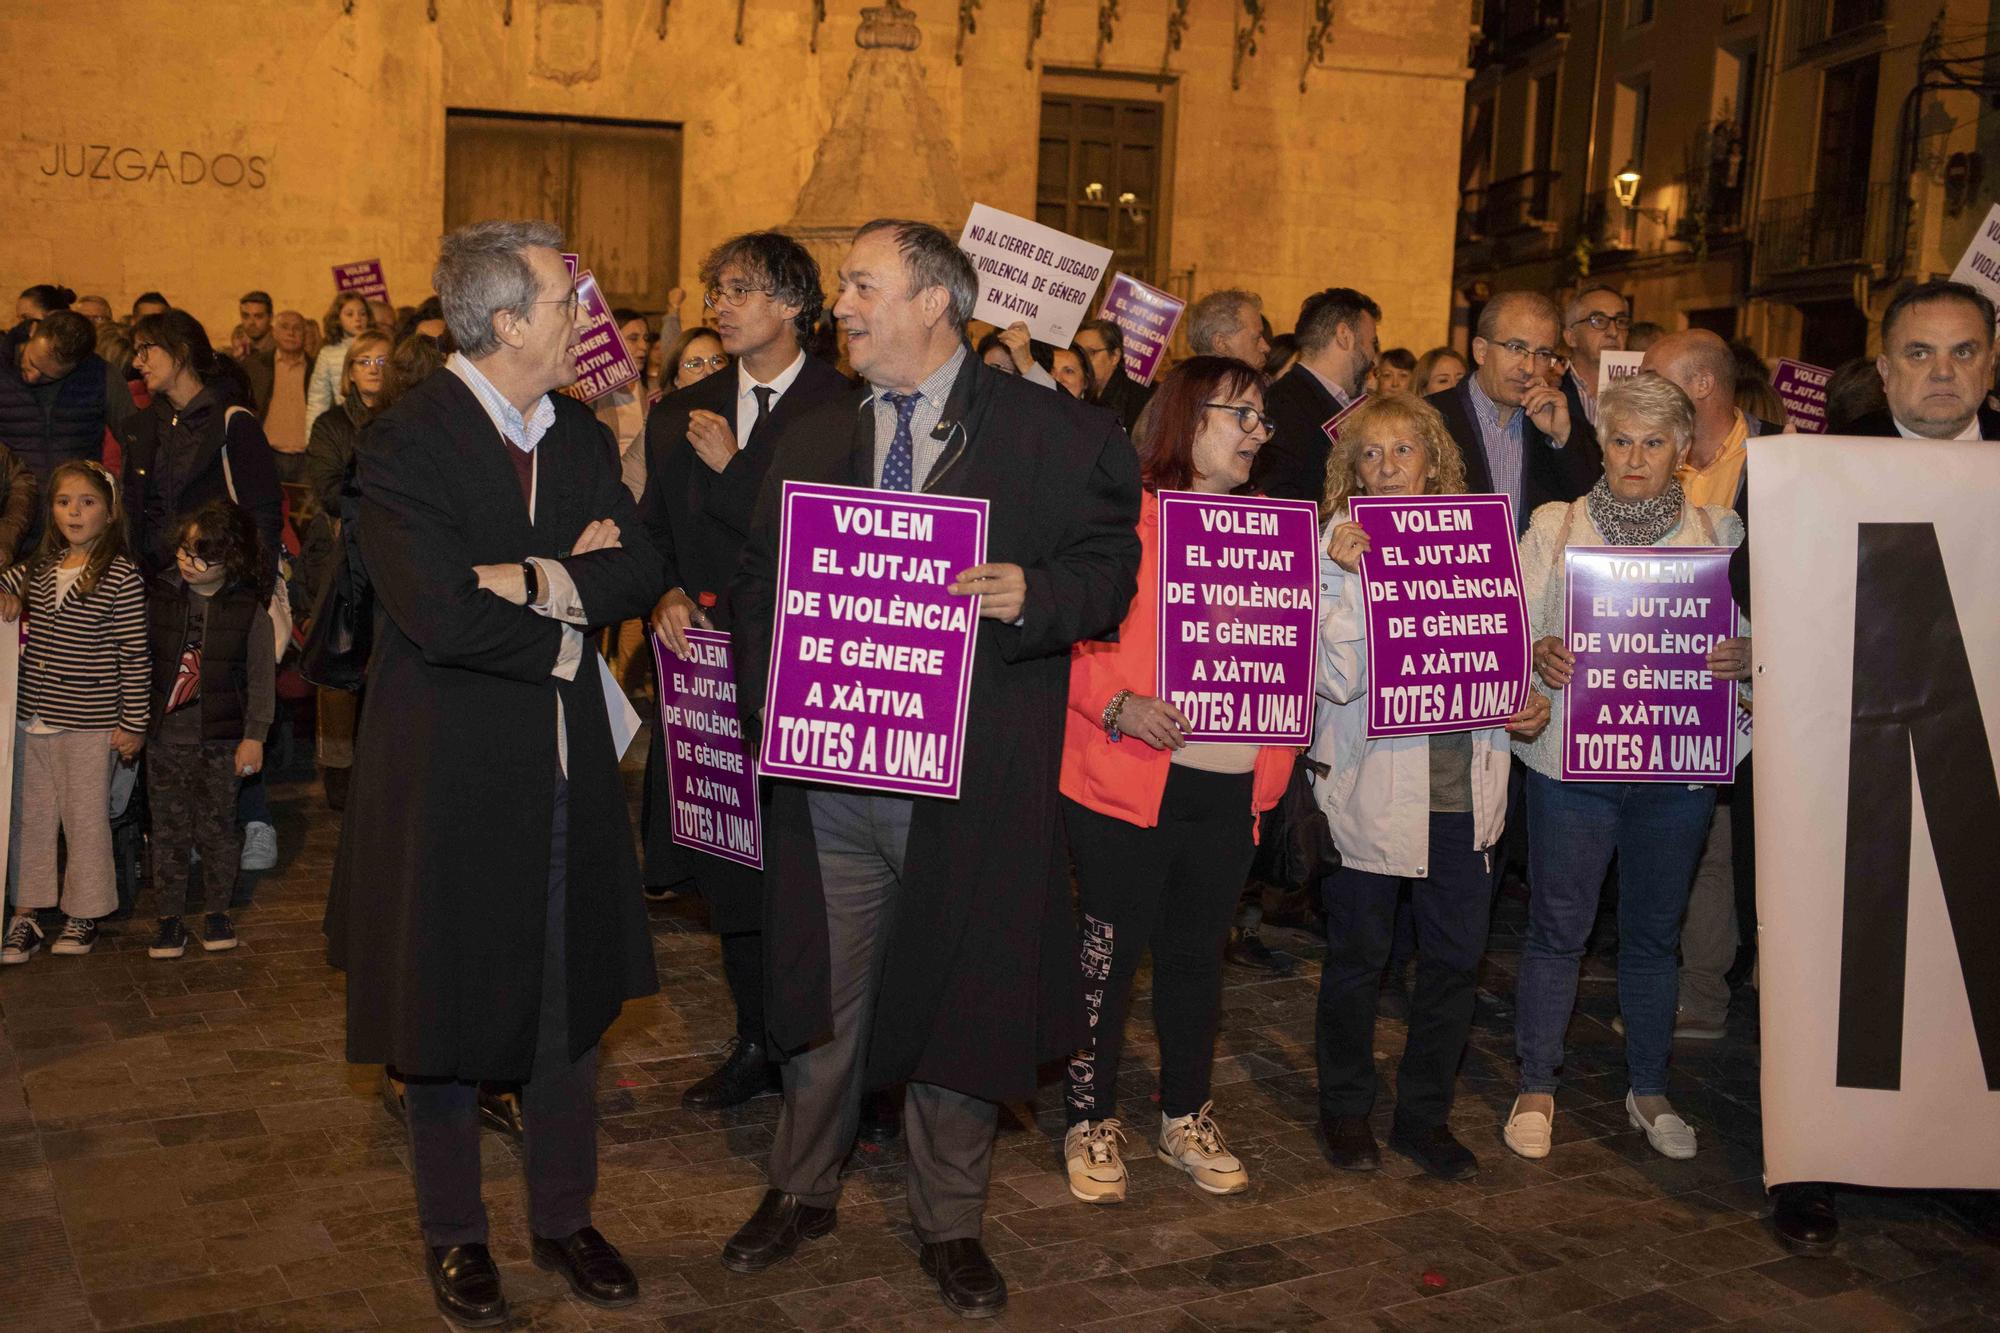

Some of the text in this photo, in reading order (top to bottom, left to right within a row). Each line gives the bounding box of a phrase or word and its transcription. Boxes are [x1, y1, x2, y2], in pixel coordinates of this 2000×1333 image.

[40, 143, 266, 189] JUZGADOS
[969, 225, 1100, 282] NO AL CIERRE DEL JUZGADO
[978, 256, 1029, 286] VIOLENCIA
[1031, 276, 1048, 292] DE
[1048, 281, 1087, 305] GÉNERO
[987, 288, 1003, 304] EN
[1116, 297, 1127, 310] EL
[568, 358, 632, 401] OTES A UNA!
[1608, 365, 1640, 381] VOLE
[1780, 381, 1826, 401] EL JUTJA
[832, 504, 934, 542] VOLEM
[1199, 508, 1279, 536] VOLEM
[1391, 509, 1473, 533] VOLEM
[811, 547, 951, 585] EL JUTJAT
[1185, 545, 1295, 572] EL JUTJAT
[1381, 543, 1492, 566] EL JUTJAT
[1608, 561, 1695, 584] VOLEM
[1167, 581, 1313, 610] DE VIOLÈNCIA
[1369, 574, 1519, 602] DE VIOLÈNCIA
[786, 589, 967, 632] DE VIOLÈNCIA
[1592, 596, 1711, 618] EL JUTJAT
[1181, 618, 1297, 647] DE GÈNERE
[1388, 610, 1508, 638] DE GÈNERE
[684, 642, 728, 669] OLEM
[799, 635, 945, 675] DE GÈNERE
[1573, 632, 1601, 653] DE
[1191, 656, 1286, 684] A XÀTIVA
[1400, 648, 1500, 676] A XÀTIVA
[673, 672, 737, 703] EL JUTJAT
[1587, 664, 1713, 690] DE GÈNERE
[804, 680, 924, 719] A XÀTIVA
[1171, 691, 1303, 733] TOTES A UNA!
[1380, 680, 1518, 724] TOTES A UNA!
[1596, 700, 1701, 726] A XÀTIVA
[665, 704, 745, 740] DE VIOLÈNCI
[676, 740, 744, 775] DE GÈNERE
[778, 715, 948, 780] TOTES A UNA!
[1575, 733, 1722, 771] TOTES A UNA!
[685, 775, 741, 808] A XÀTIVA
[677, 800, 755, 855] TOTES A UNA!
